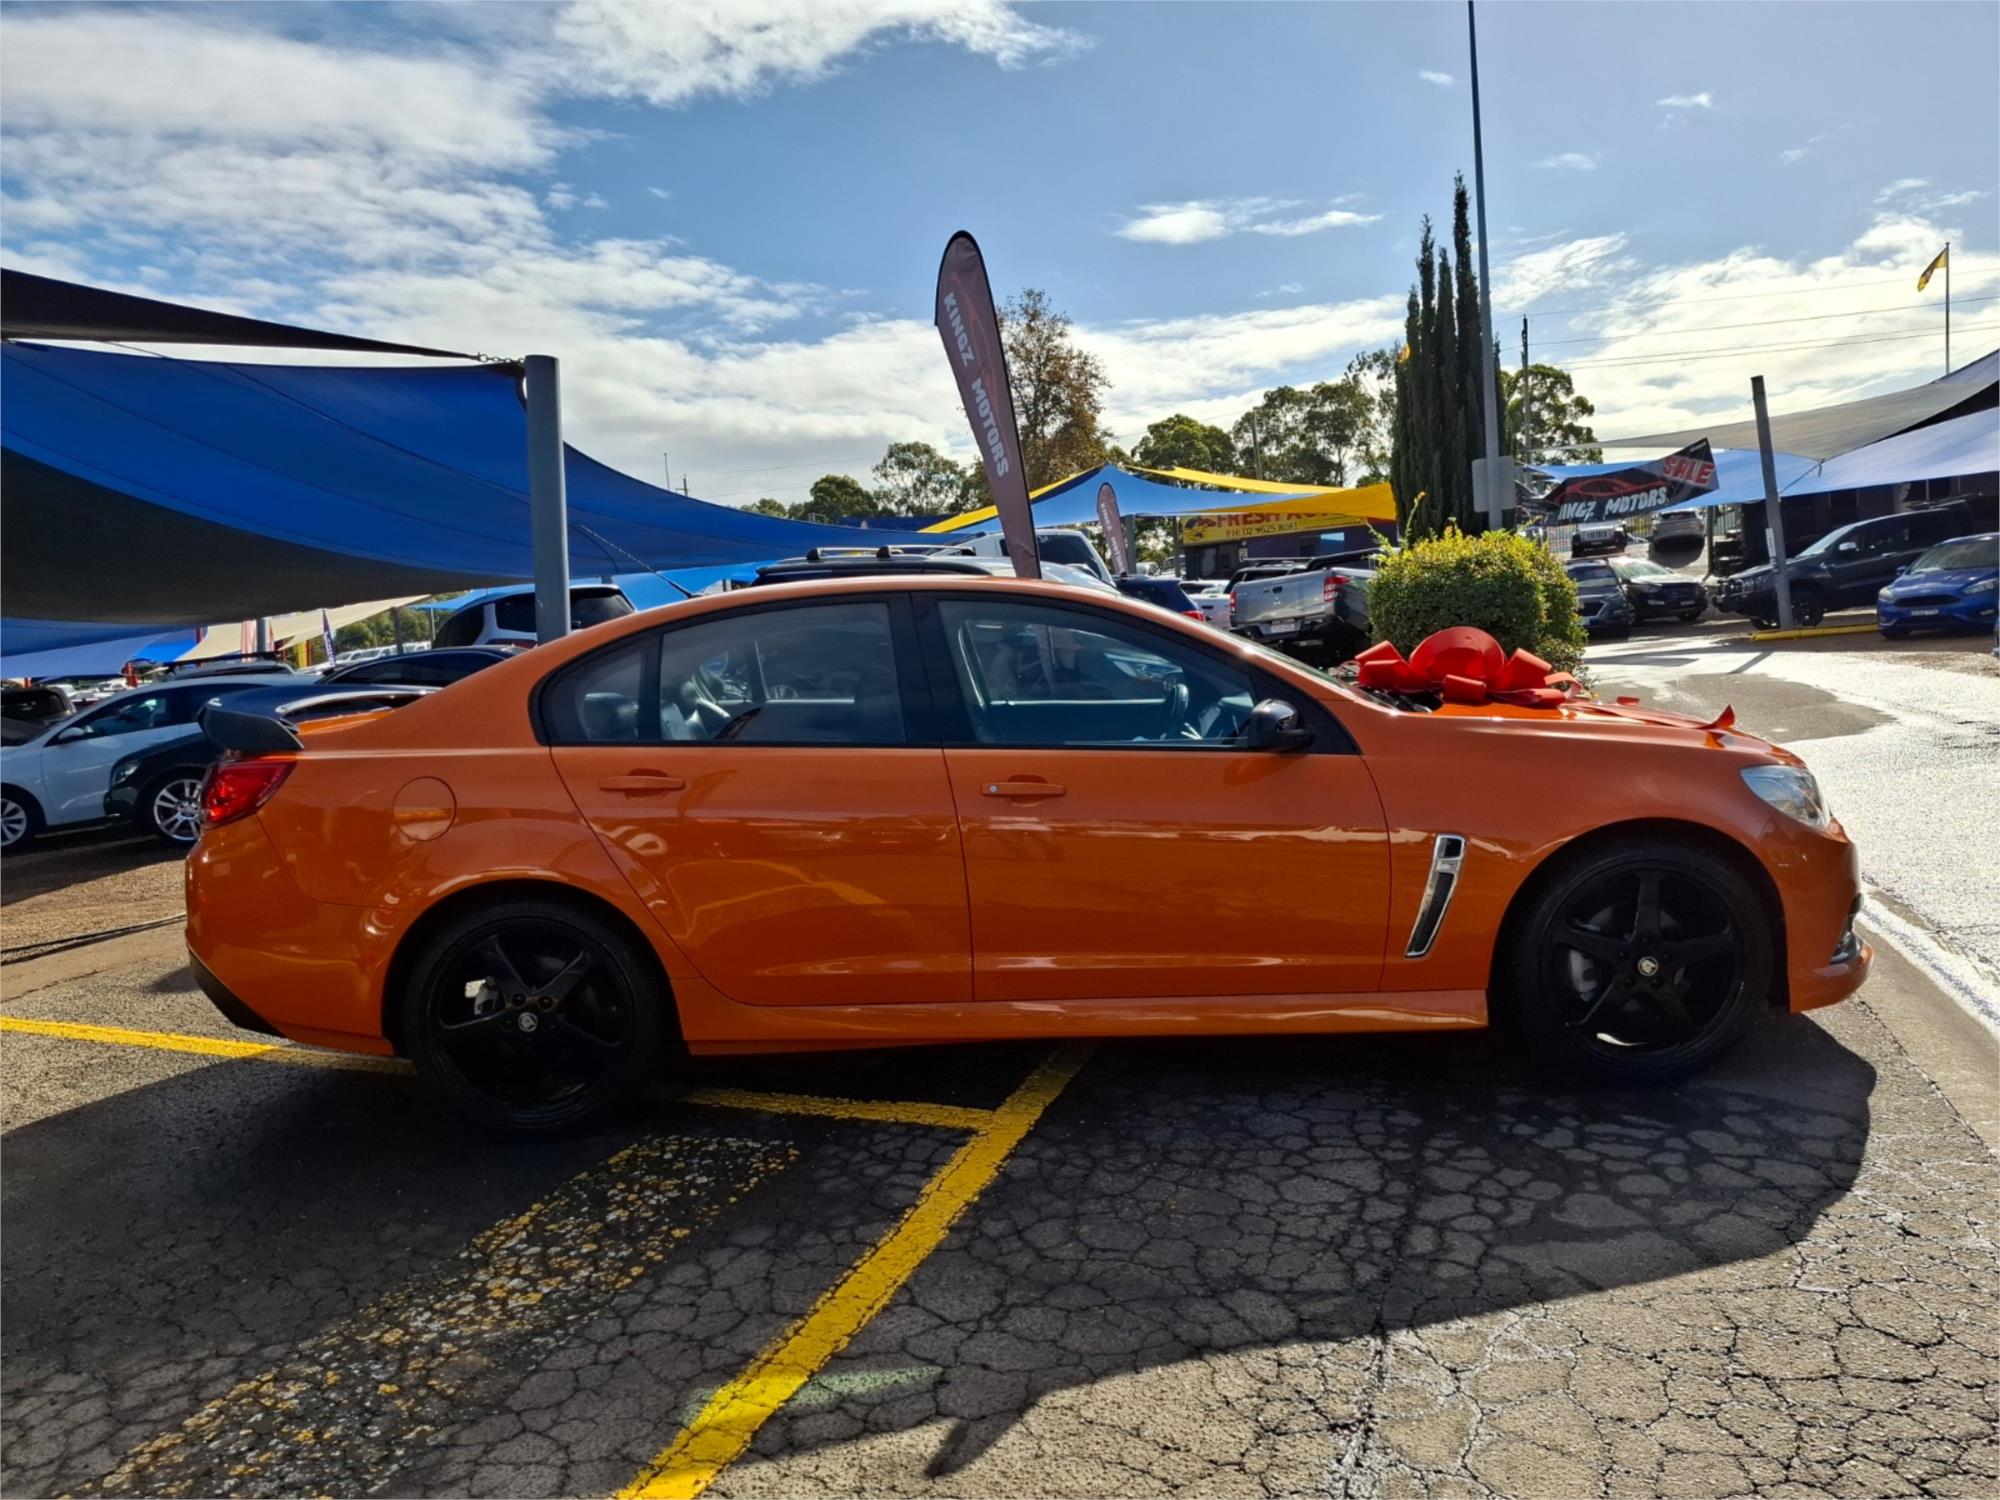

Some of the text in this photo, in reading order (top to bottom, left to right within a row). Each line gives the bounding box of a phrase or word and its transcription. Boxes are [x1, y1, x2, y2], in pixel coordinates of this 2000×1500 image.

[943, 292, 1009, 478] KINGZ MOTORS
[1663, 455, 1716, 485] SALE
[1604, 486, 1668, 516] MOTORS
